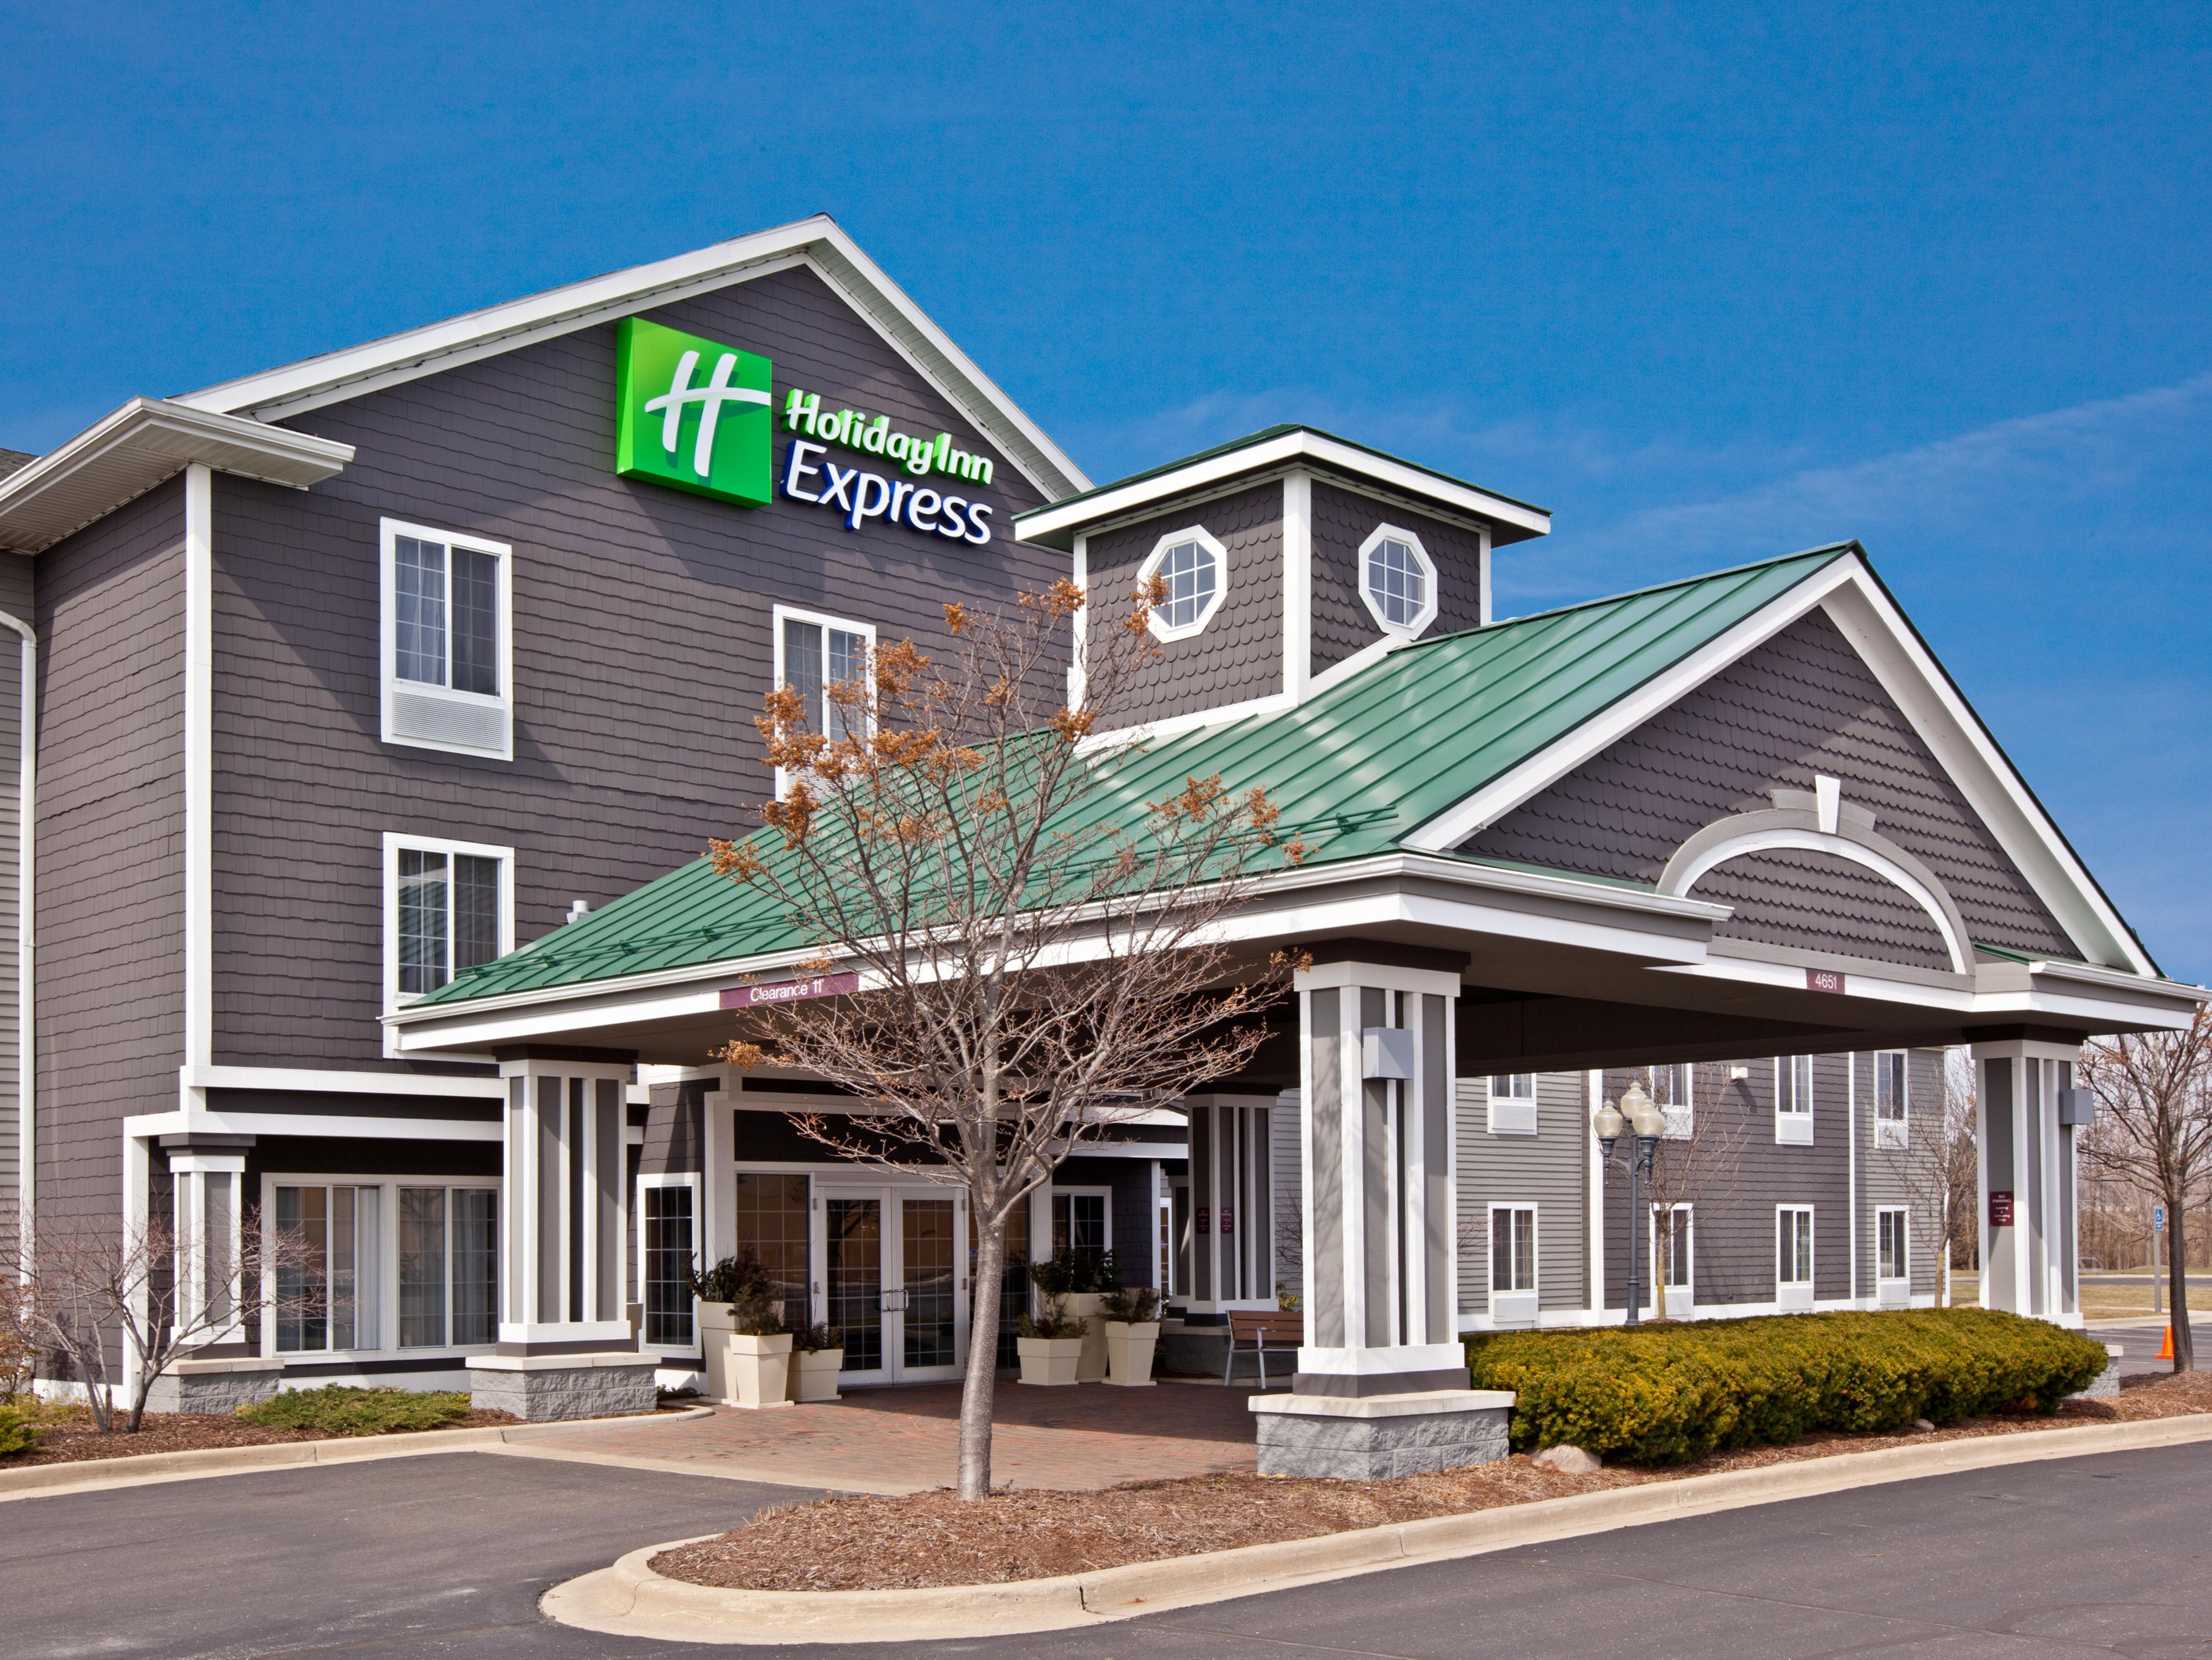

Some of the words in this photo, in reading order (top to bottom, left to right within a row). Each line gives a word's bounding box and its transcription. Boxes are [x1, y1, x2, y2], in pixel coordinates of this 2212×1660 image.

[782, 440, 993, 544] Express
[1815, 974, 1837, 990] 4651
[750, 984, 808, 1002] Clearance
